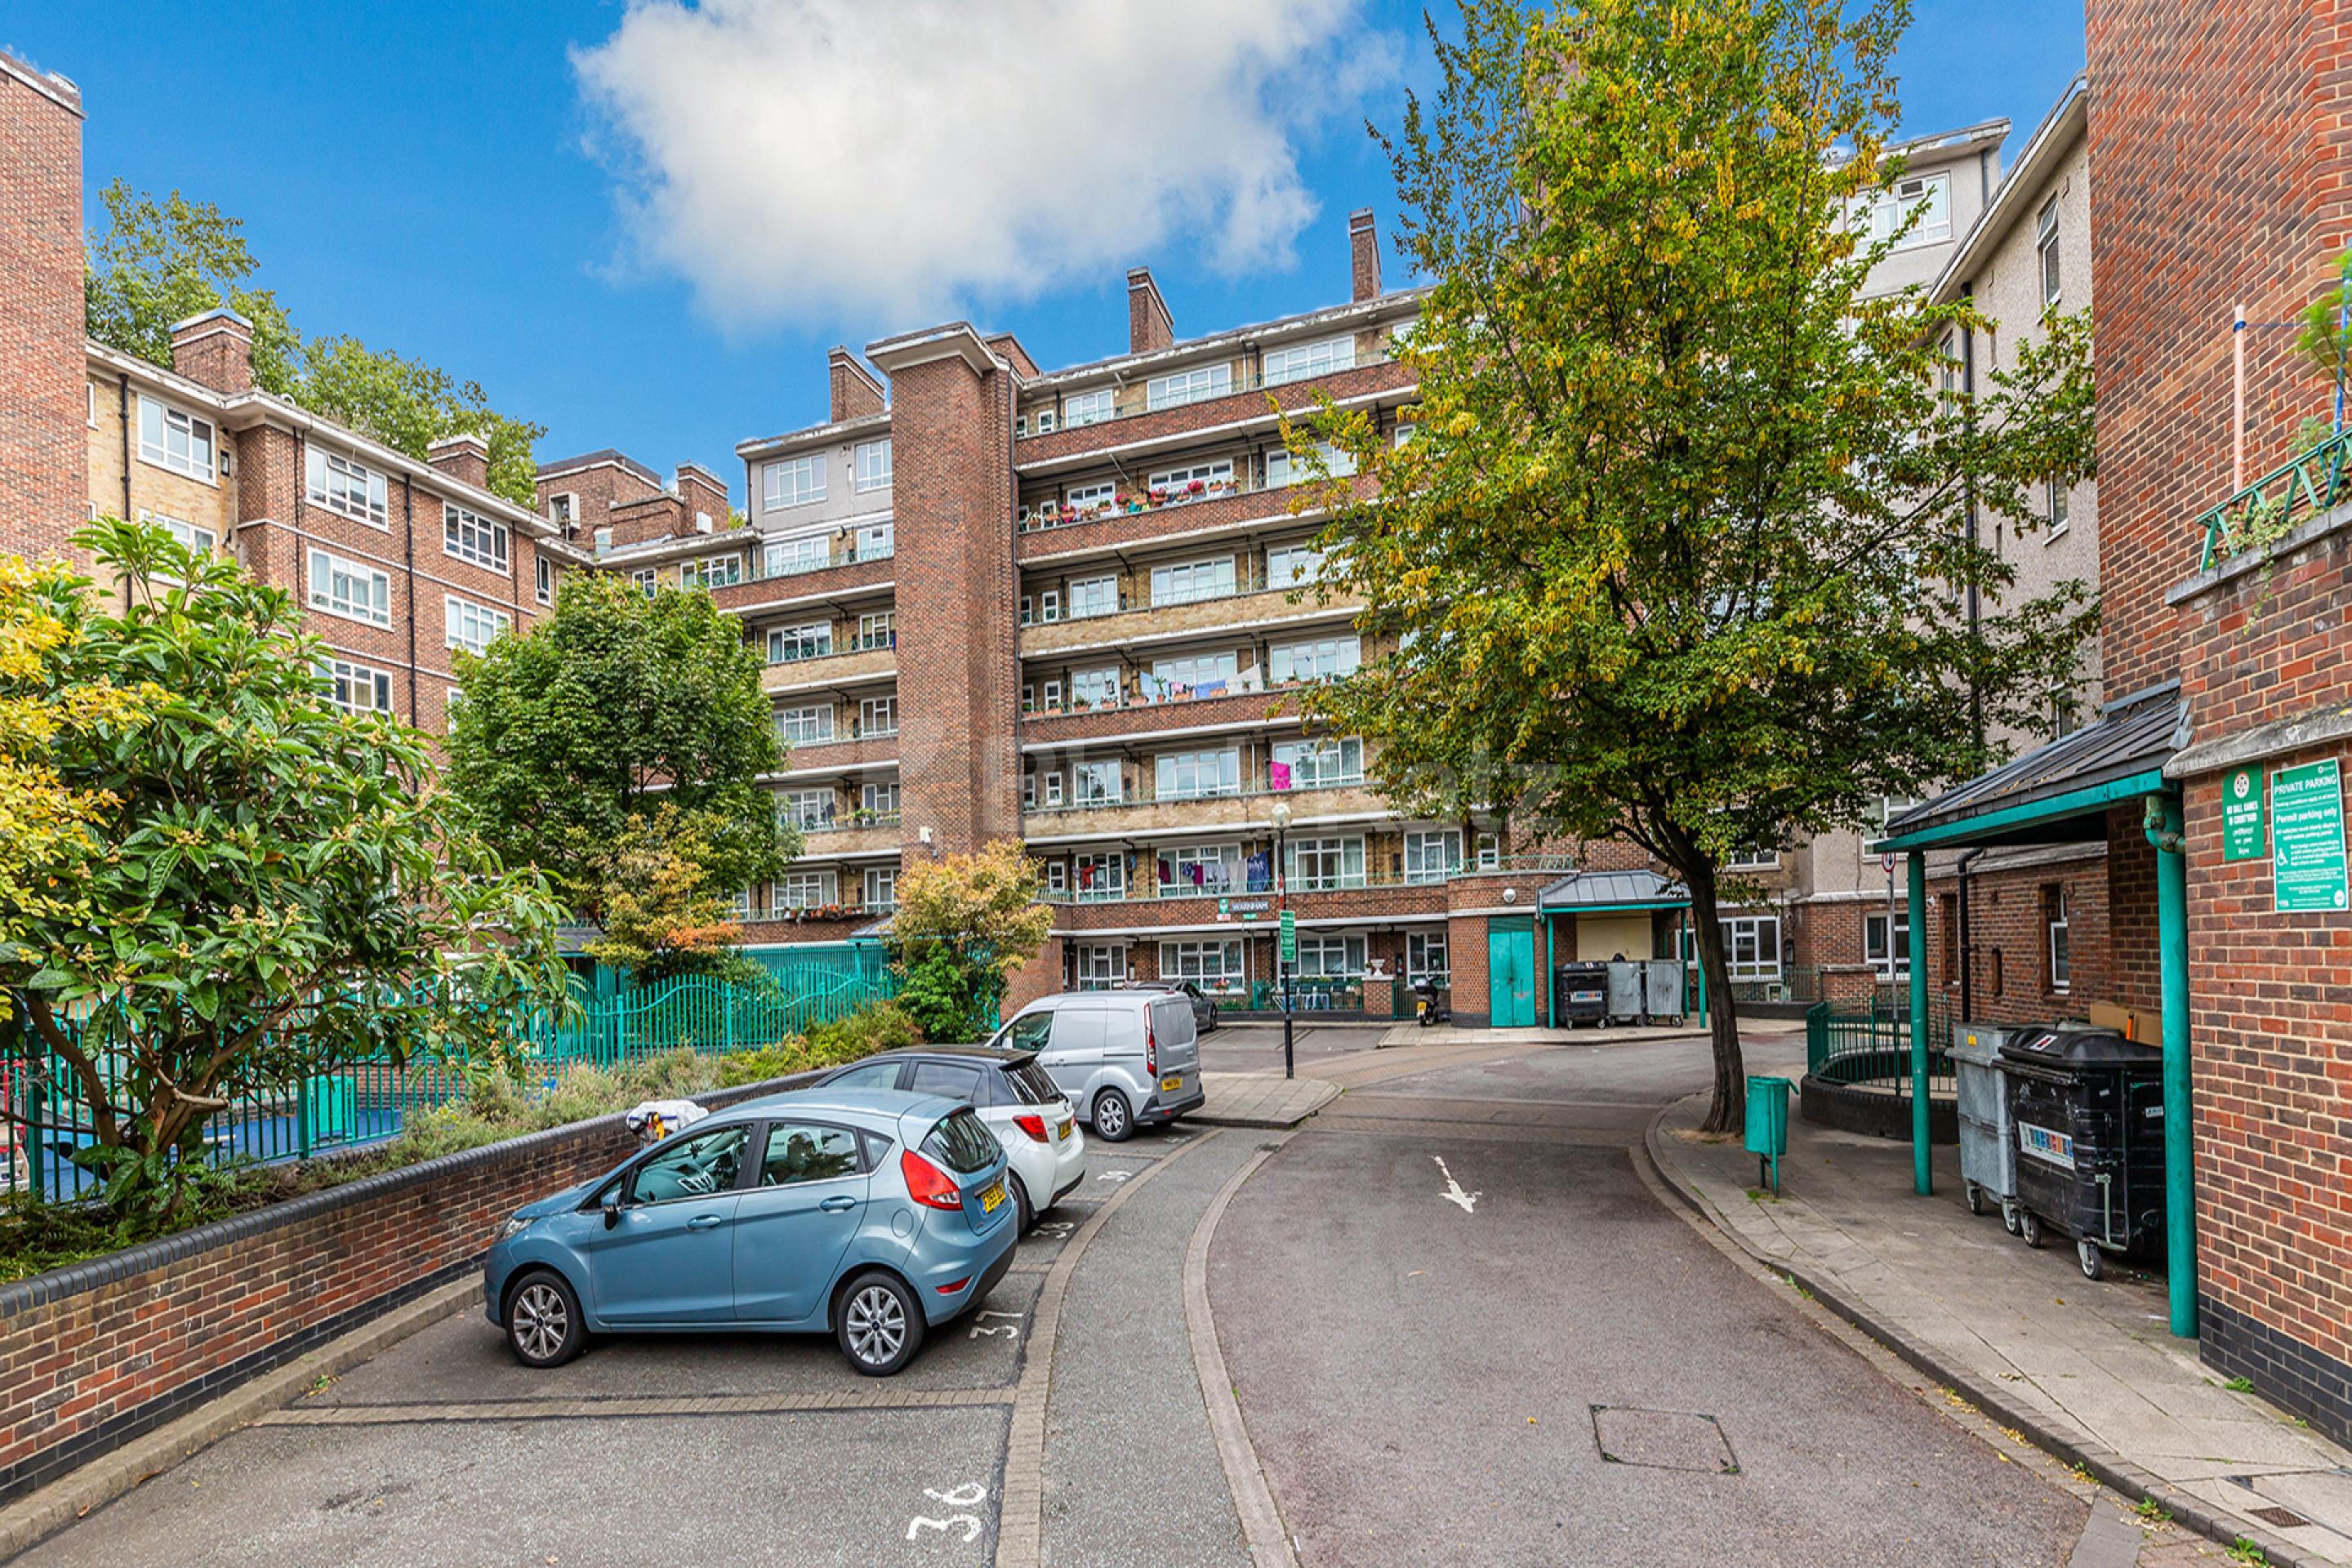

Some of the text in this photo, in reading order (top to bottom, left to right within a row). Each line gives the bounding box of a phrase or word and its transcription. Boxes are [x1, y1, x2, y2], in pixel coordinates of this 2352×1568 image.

[2274, 773, 2336, 795] PRIVATE PARKING
[2276, 806, 2337, 824] Permit parking only
[905, 1481, 987, 1542] 36
